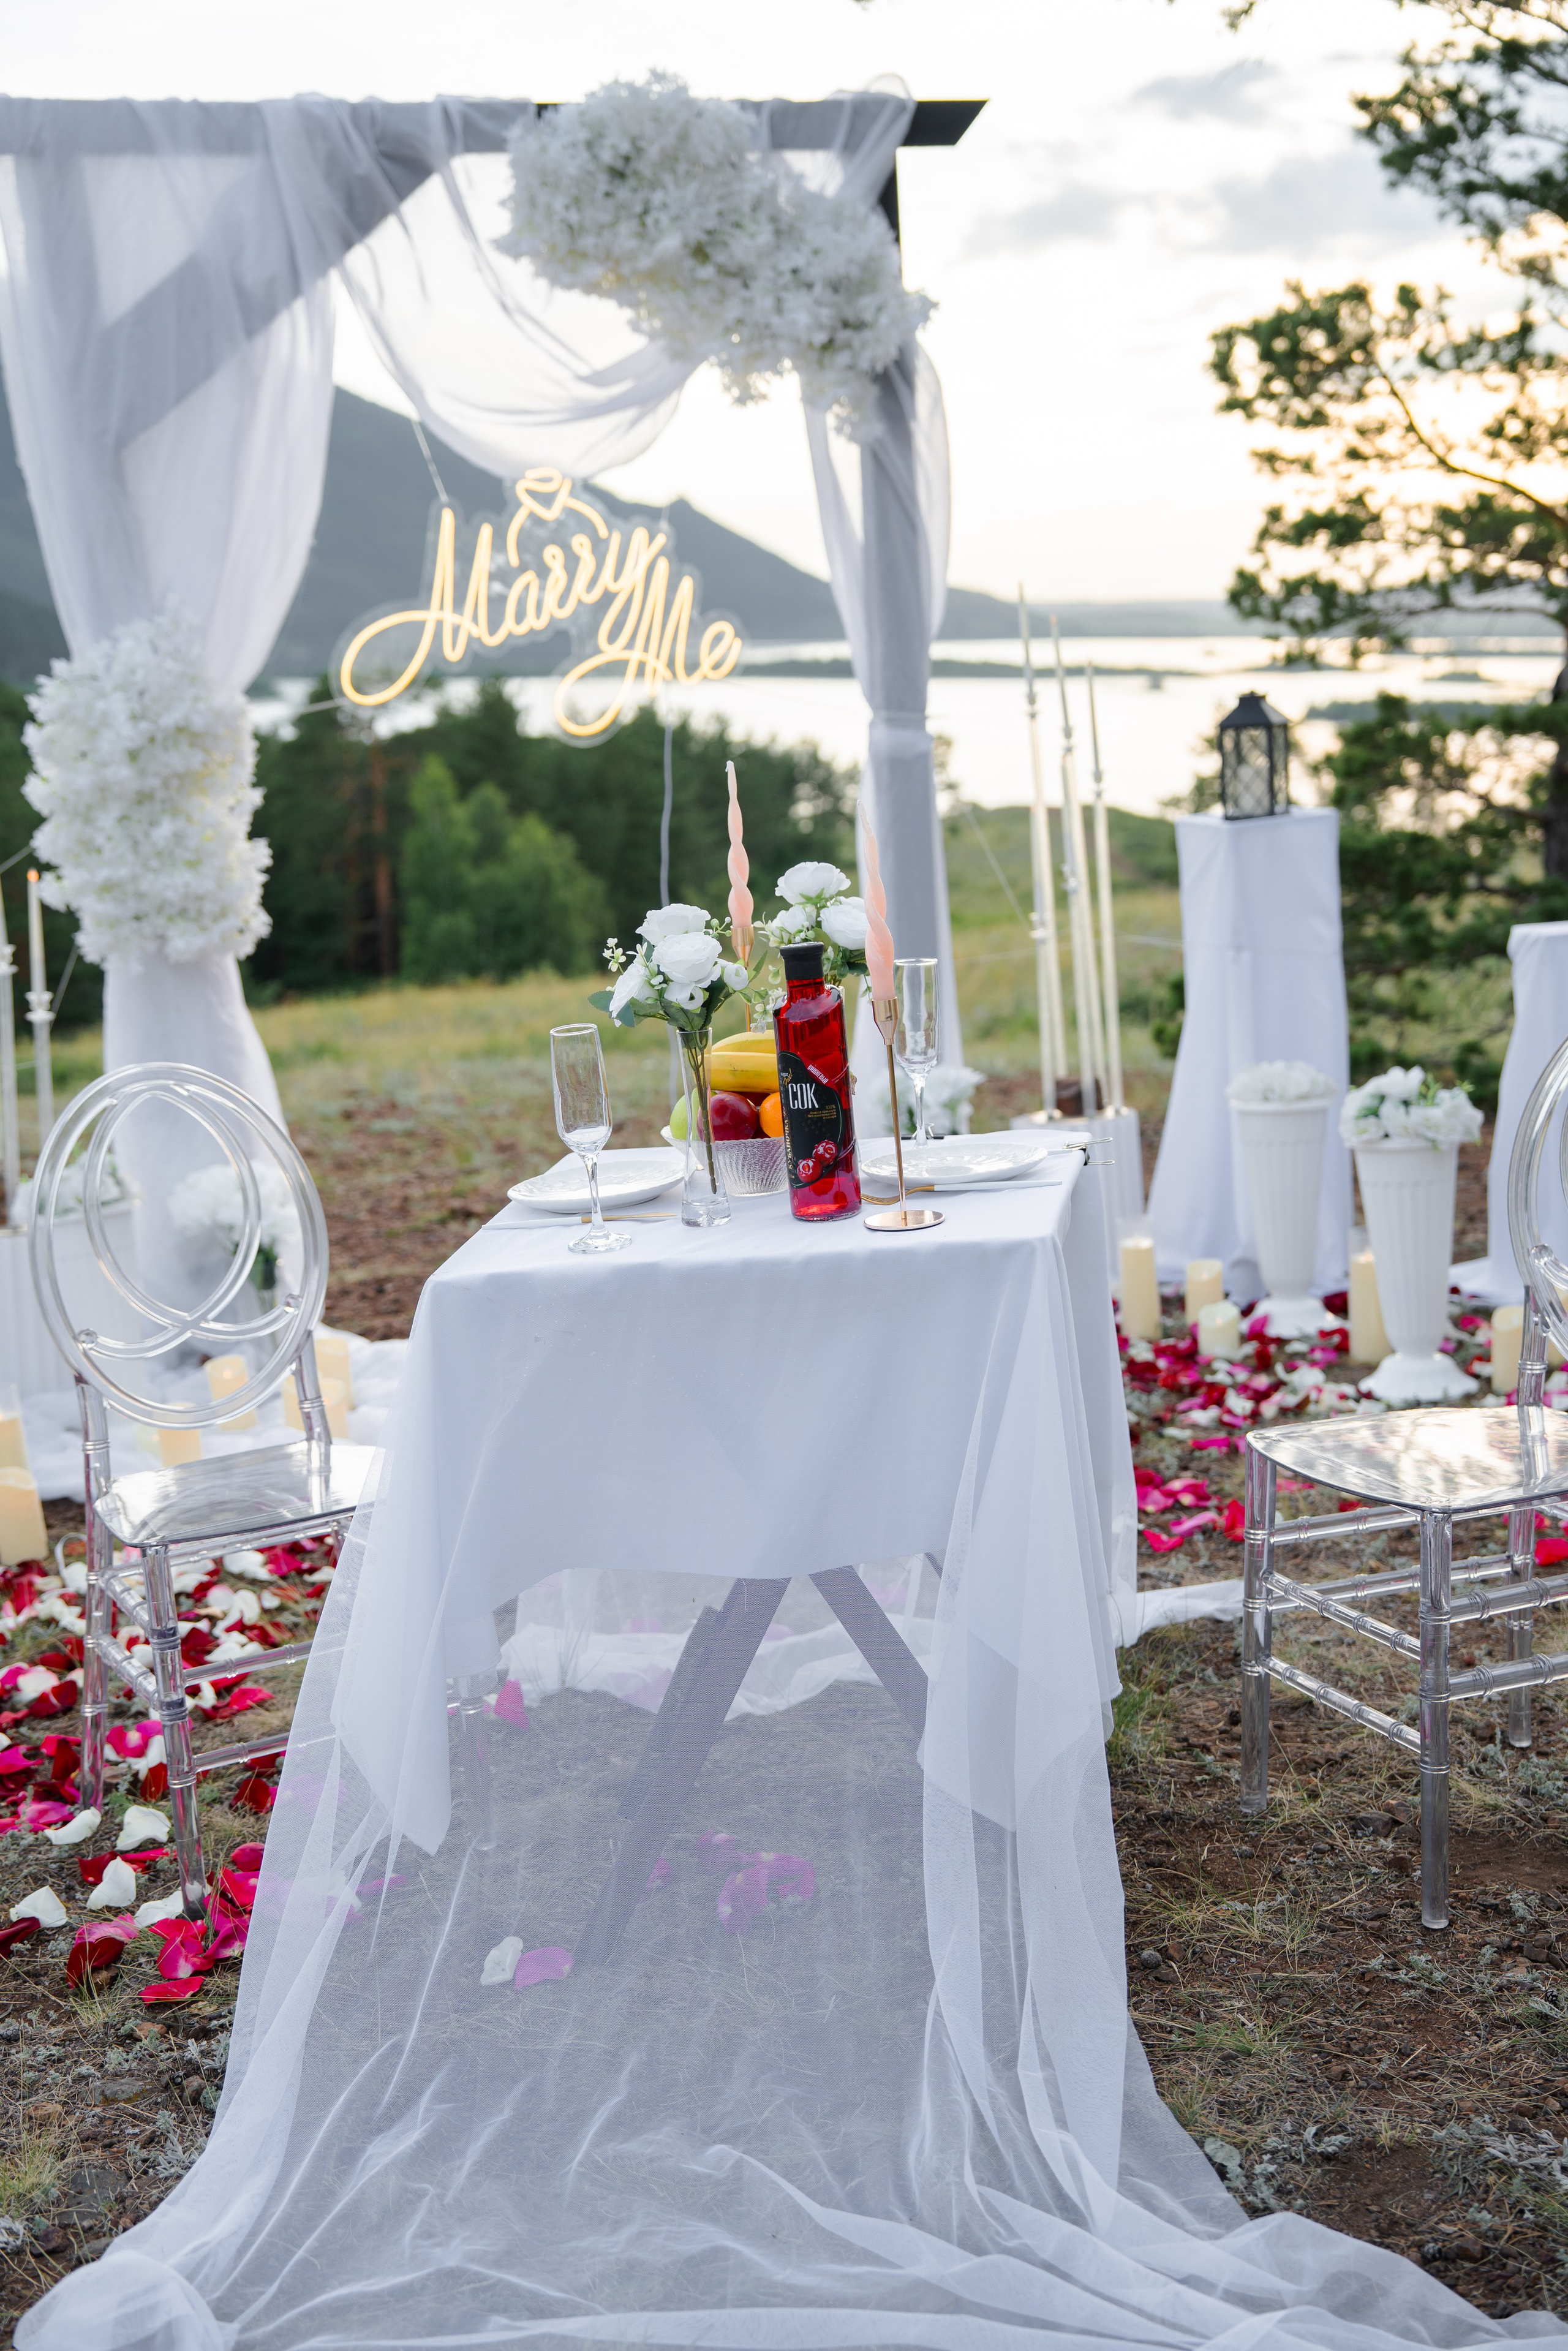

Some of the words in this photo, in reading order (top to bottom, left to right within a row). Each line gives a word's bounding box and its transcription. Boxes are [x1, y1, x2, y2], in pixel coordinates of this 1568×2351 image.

[341, 507, 667, 706] Marry
[554, 556, 742, 736] Me
[788, 1083, 818, 1109] СОК
